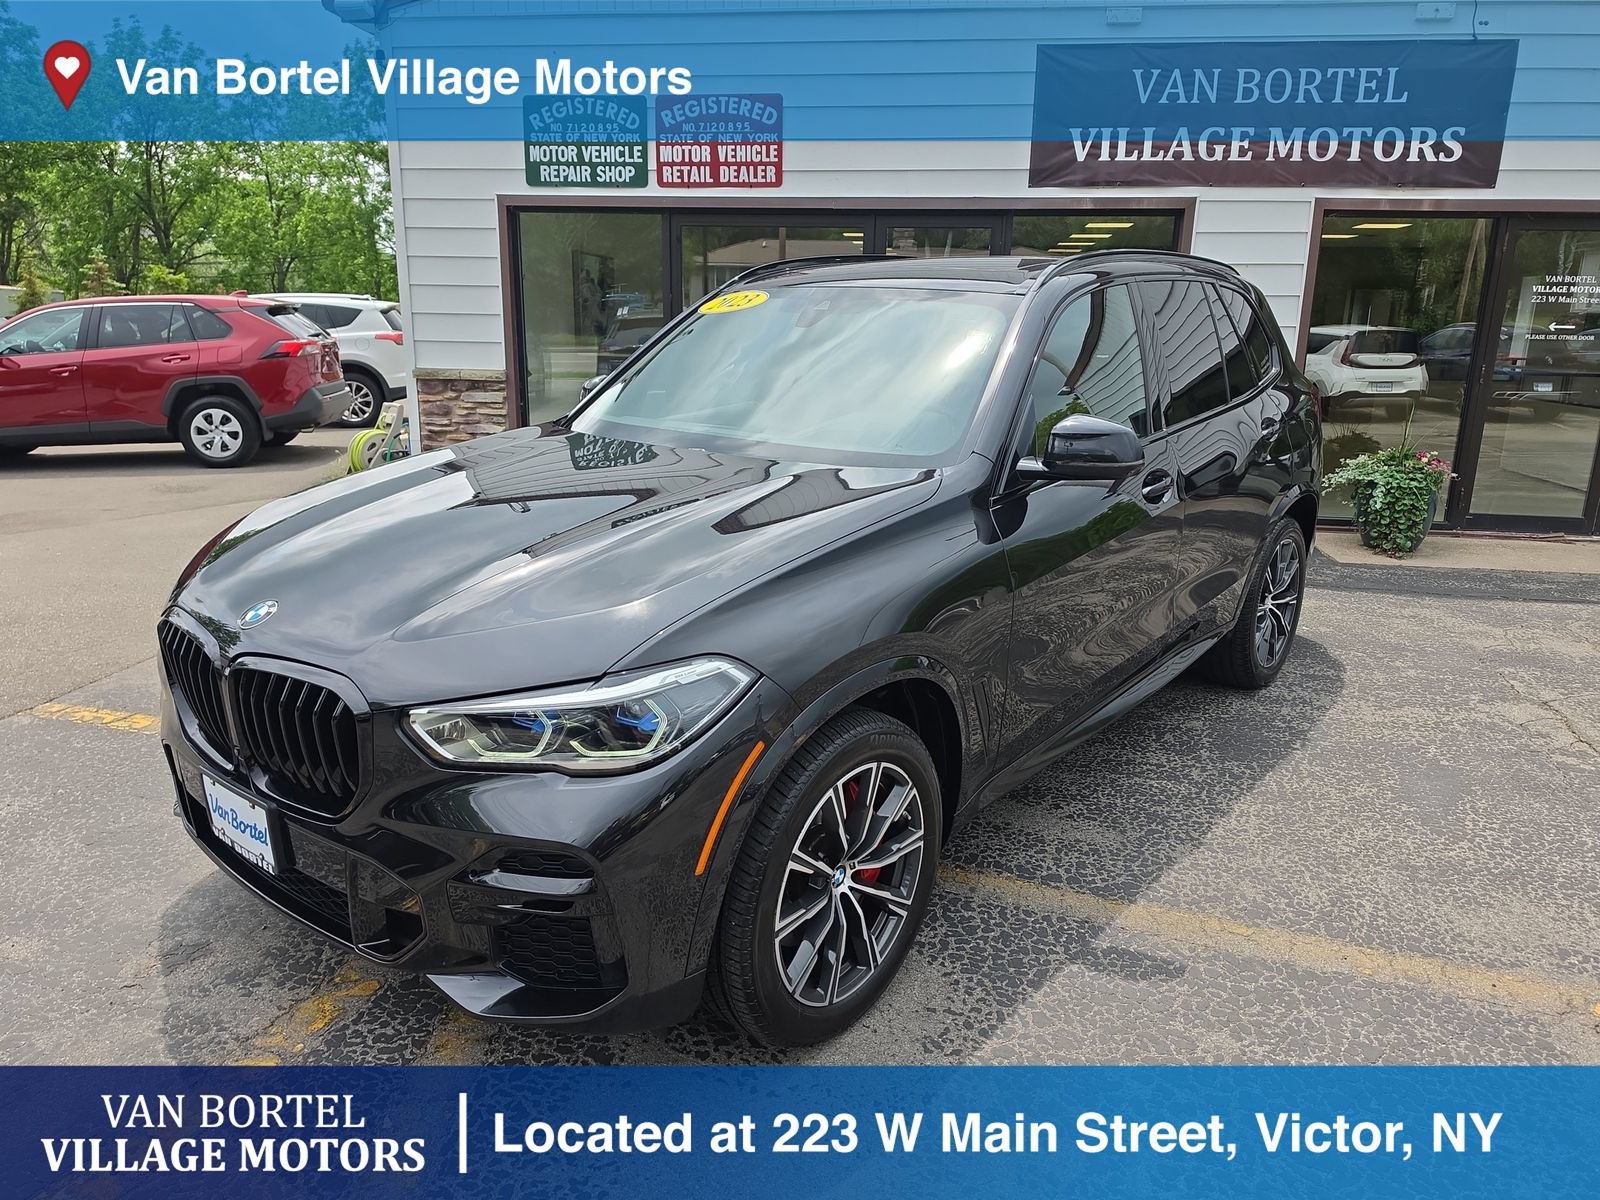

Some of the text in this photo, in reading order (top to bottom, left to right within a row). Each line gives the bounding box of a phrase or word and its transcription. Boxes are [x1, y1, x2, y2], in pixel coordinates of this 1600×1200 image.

[1132, 66, 1408, 104] VAN BORTEL
[528, 97, 640, 130] REGISTERED
[660, 96, 778, 128] REGISTERED
[567, 123, 620, 133] 7120895
[698, 121, 751, 132] 7120895
[530, 133, 641, 142] STATE OF NEW YORK
[660, 133, 779, 143] STATE OF NEW YORK
[1069, 126, 1466, 163] VILLAGE MOTORS
[529, 145, 643, 162] MOTOR VEHICLE
[659, 144, 779, 162] MOTOR VEHICLE
[540, 165, 635, 182] REPAIR SHOP
[662, 166, 776, 182] RETAIL DEALER
[1545, 275, 1597, 284] VAN BORTEL
[1532, 285, 1568, 293] VILLAGE
[705, 293, 762, 311] 2023
[1531, 295, 1600, 304] 223 W Main Stree
